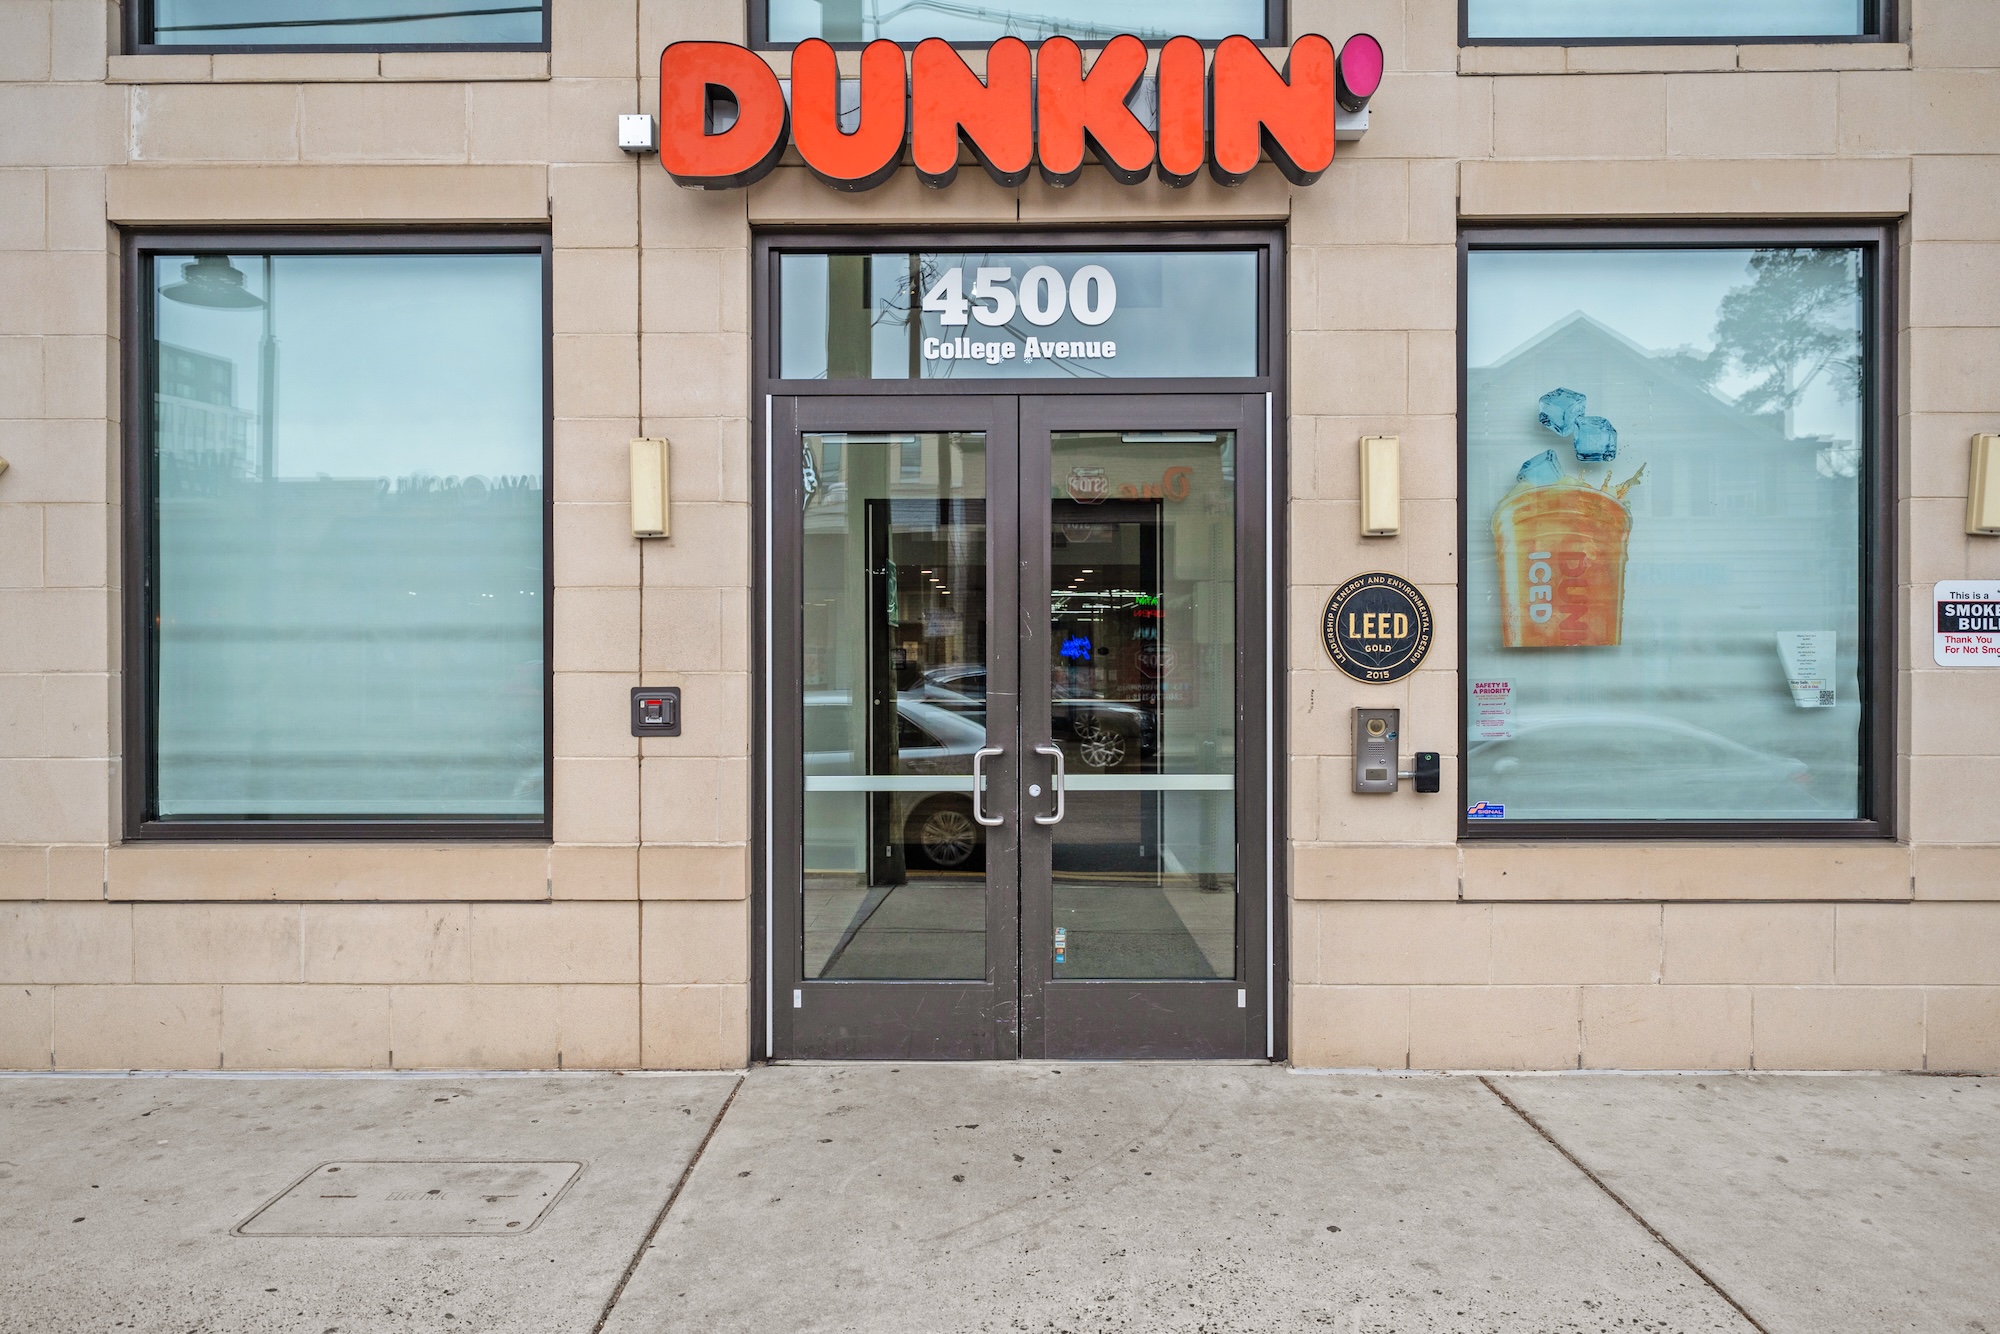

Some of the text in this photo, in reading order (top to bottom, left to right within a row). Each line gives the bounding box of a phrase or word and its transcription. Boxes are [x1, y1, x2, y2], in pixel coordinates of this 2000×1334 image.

[659, 33, 1384, 191] DUNKIN'
[923, 265, 1117, 326] 4500
[923, 336, 1117, 364] College Avenue
[1528, 552, 1552, 624] ICED
[1949, 591, 1970, 600] This
[1972, 591, 1981, 600] is
[1326, 576, 1430, 664] LEADERSHIP IN ENERGY AND ENVIRONMENTAL DESIGN
[1349, 612, 1408, 639] LEED
[1959, 618, 2000, 630] BUIL
[1364, 644, 1392, 653] GOLD
[1945, 645, 1960, 654] For
[1963, 645, 1979, 654] Not
[1366, 671, 1390, 679] 2015
